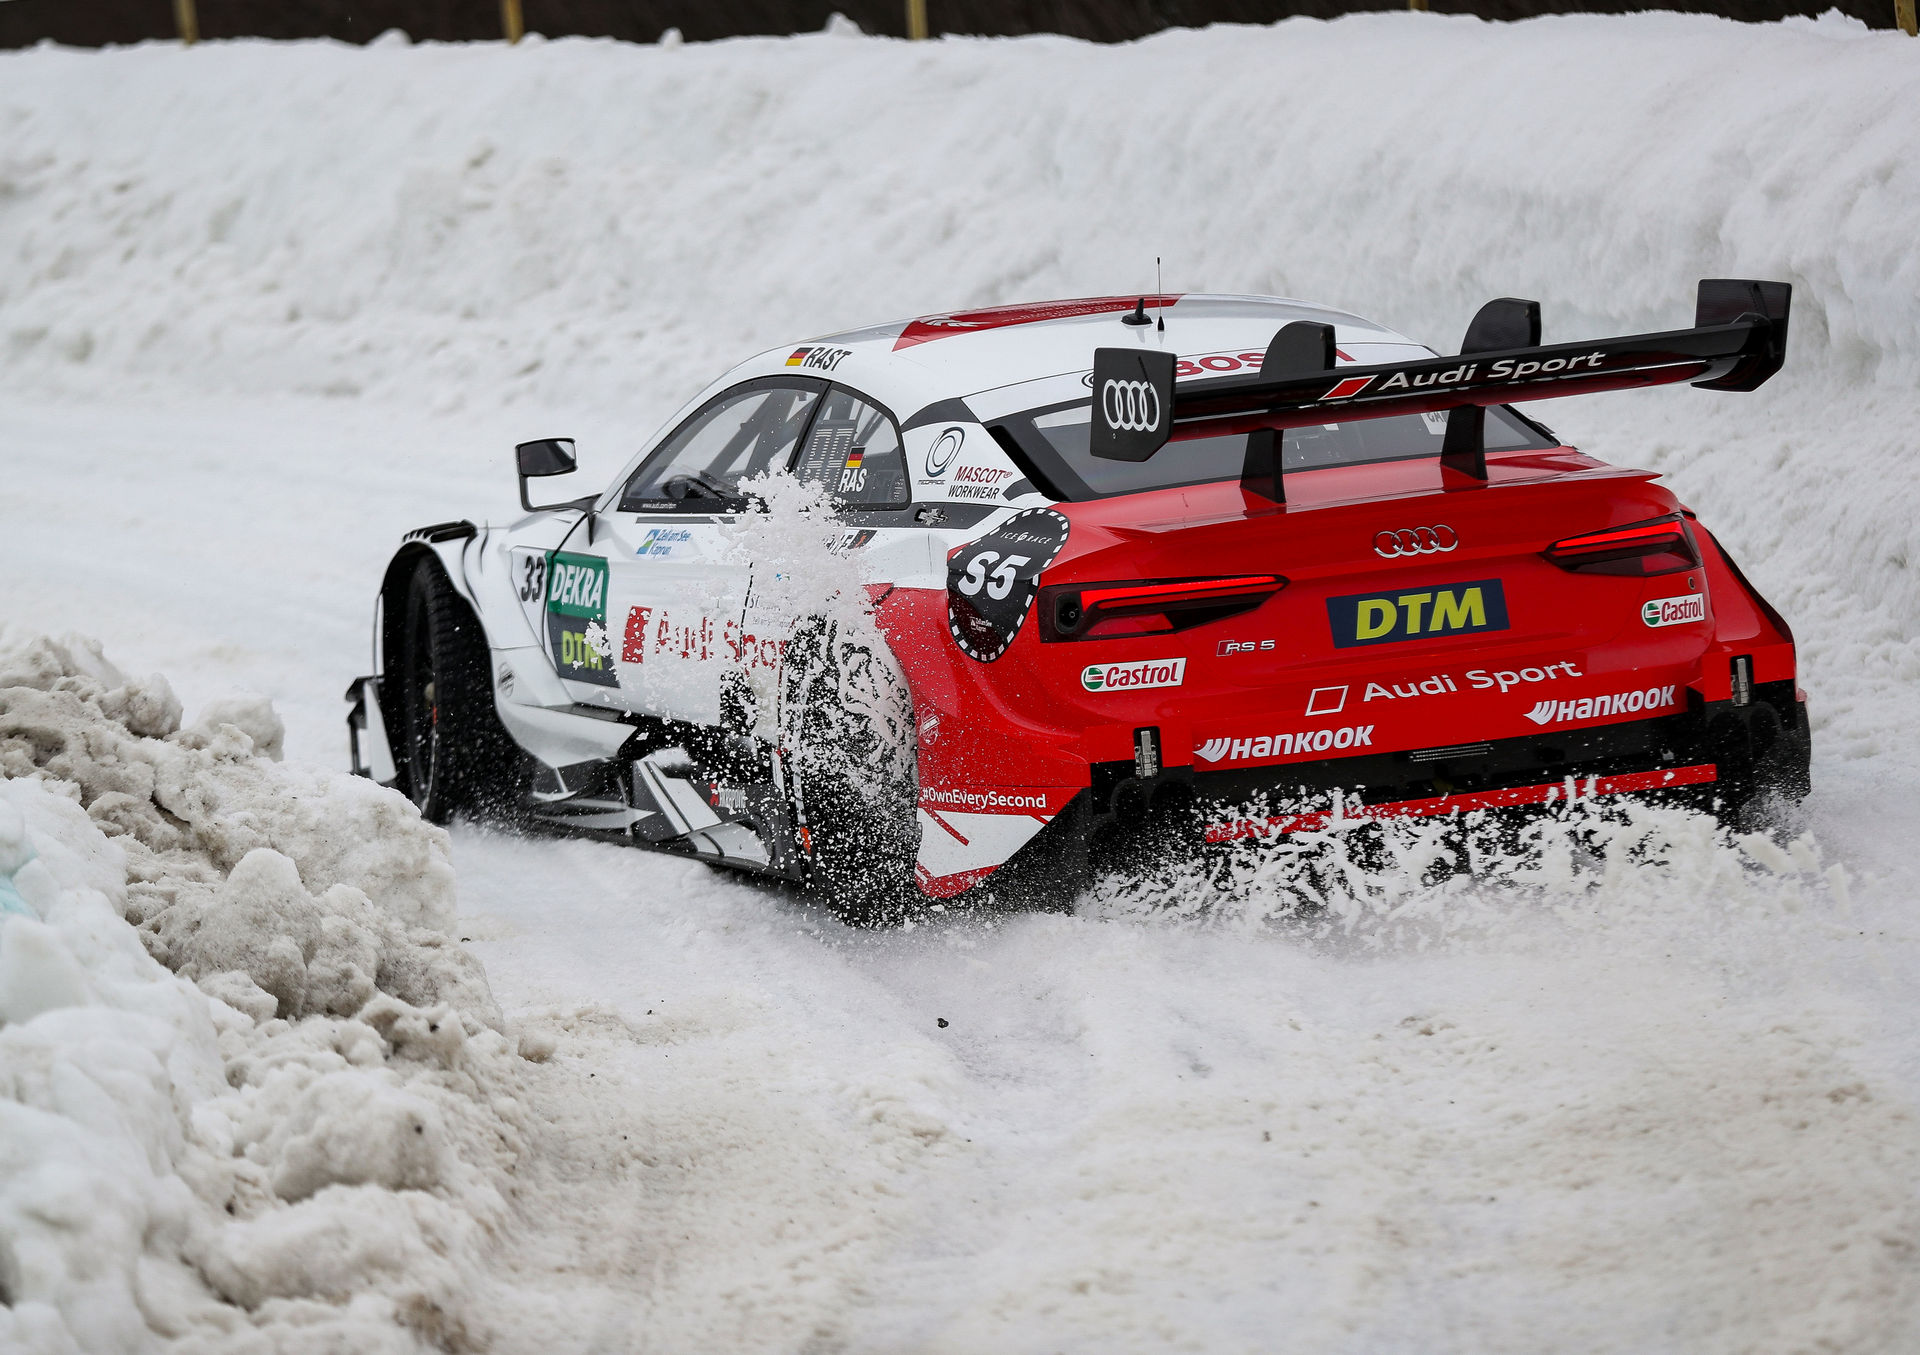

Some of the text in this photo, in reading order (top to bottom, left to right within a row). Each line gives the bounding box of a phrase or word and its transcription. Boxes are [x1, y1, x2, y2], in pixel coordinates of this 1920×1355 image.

[803, 347, 853, 371] RAST
[1176, 349, 1356, 377] BOS
[1377, 351, 1606, 391] Audi Sport
[948, 485, 999, 499] WORKWEAR
[677, 529, 691, 541] See
[521, 555, 546, 602] 33
[550, 563, 604, 609] DEKRA
[958, 551, 1031, 600] S5
[1356, 587, 1487, 640] DTM
[1661, 598, 1702, 622] Castrol
[1225, 639, 1276, 652] RS 5
[1105, 662, 1178, 687] Castrol
[1363, 660, 1583, 702] Audi Sport
[922, 787, 1047, 809] #OwnEverySecond
